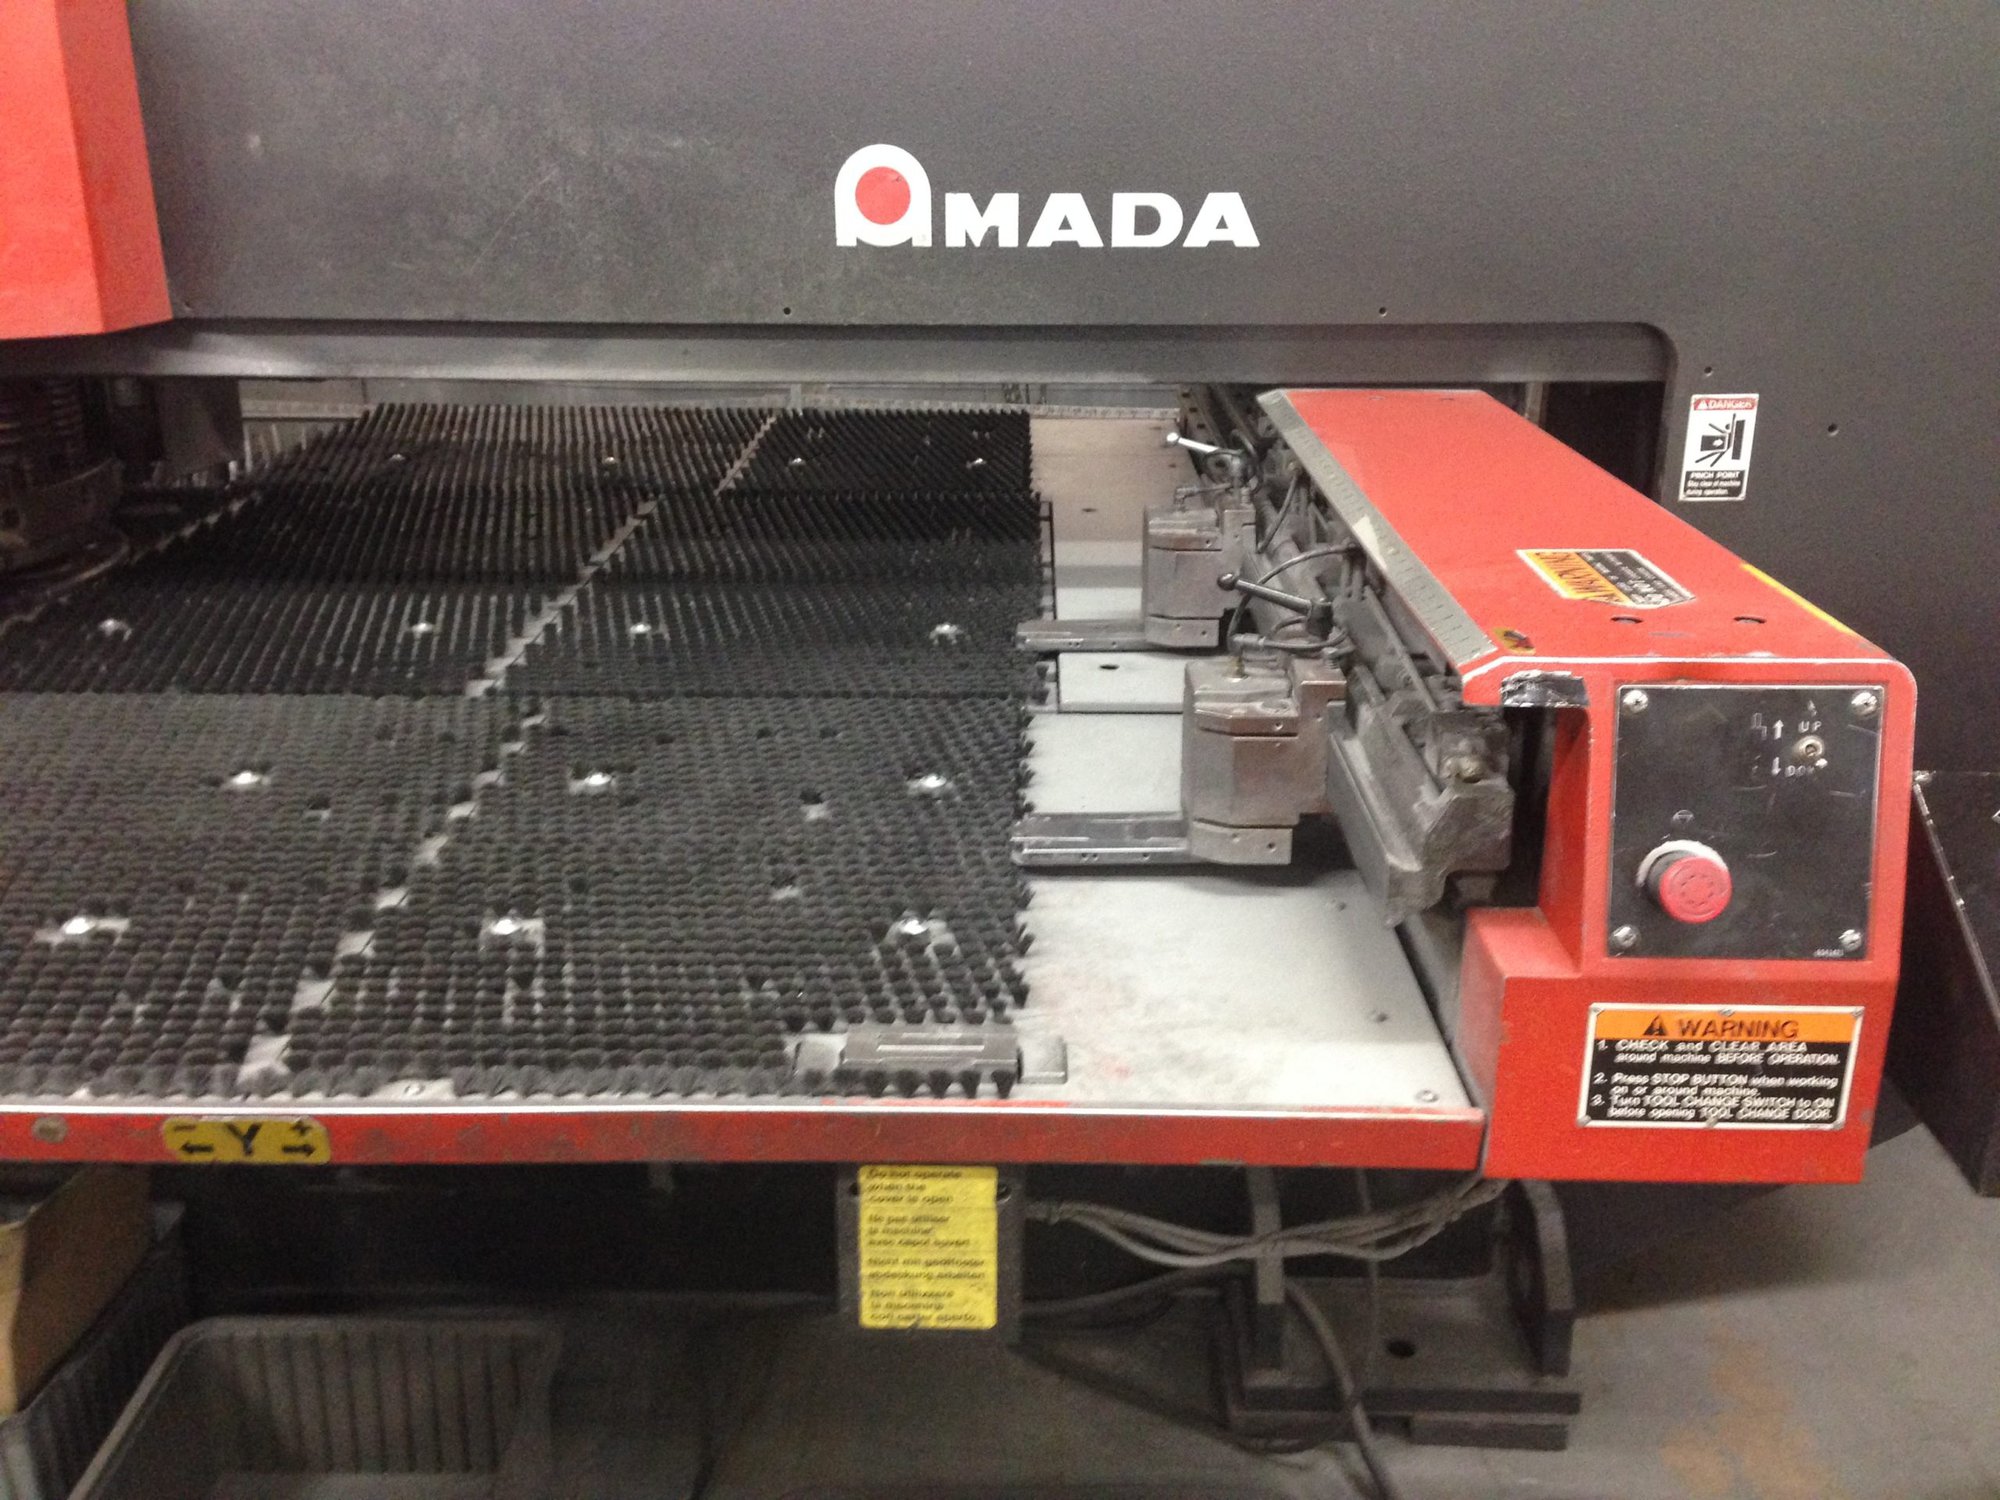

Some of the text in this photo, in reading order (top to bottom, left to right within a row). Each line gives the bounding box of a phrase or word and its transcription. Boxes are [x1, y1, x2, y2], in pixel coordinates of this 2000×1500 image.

[1798, 720, 1822, 733] UP
[1679, 1018, 1799, 1038] WARNING
[1615, 1040, 1669, 1052] CHECK
[1674, 1041, 1704, 1052] and
[1708, 1041, 1761, 1053] CLEAR
[1765, 1041, 1808, 1053] AREA
[1614, 1052, 1657, 1063] around
[1659, 1053, 1711, 1064] machine
[1714, 1053, 1765, 1065] BEFORE
[1593, 1072, 1839, 1089] 2. Press STOP BUTTON when working
[1609, 1085, 1629, 1096] on
[1632, 1086, 1649, 1096] or
[1651, 1085, 1698, 1096] around
[1610, 1095, 1641, 1107] Turn
[1642, 1095, 1681, 1107] TOOL
[1680, 1096, 1740, 1108] CHANGE
[1740, 1097, 1797, 1109] SWITCH
[1796, 1098, 1811, 1109] to
[1811, 1098, 1836, 1109] ON
[1607, 1106, 1646, 1118] before
[1699, 1107, 1734, 1119] TOOL
[1736, 1107, 1791, 1120] CHANGE
[225, 1123, 262, 1156] Y
